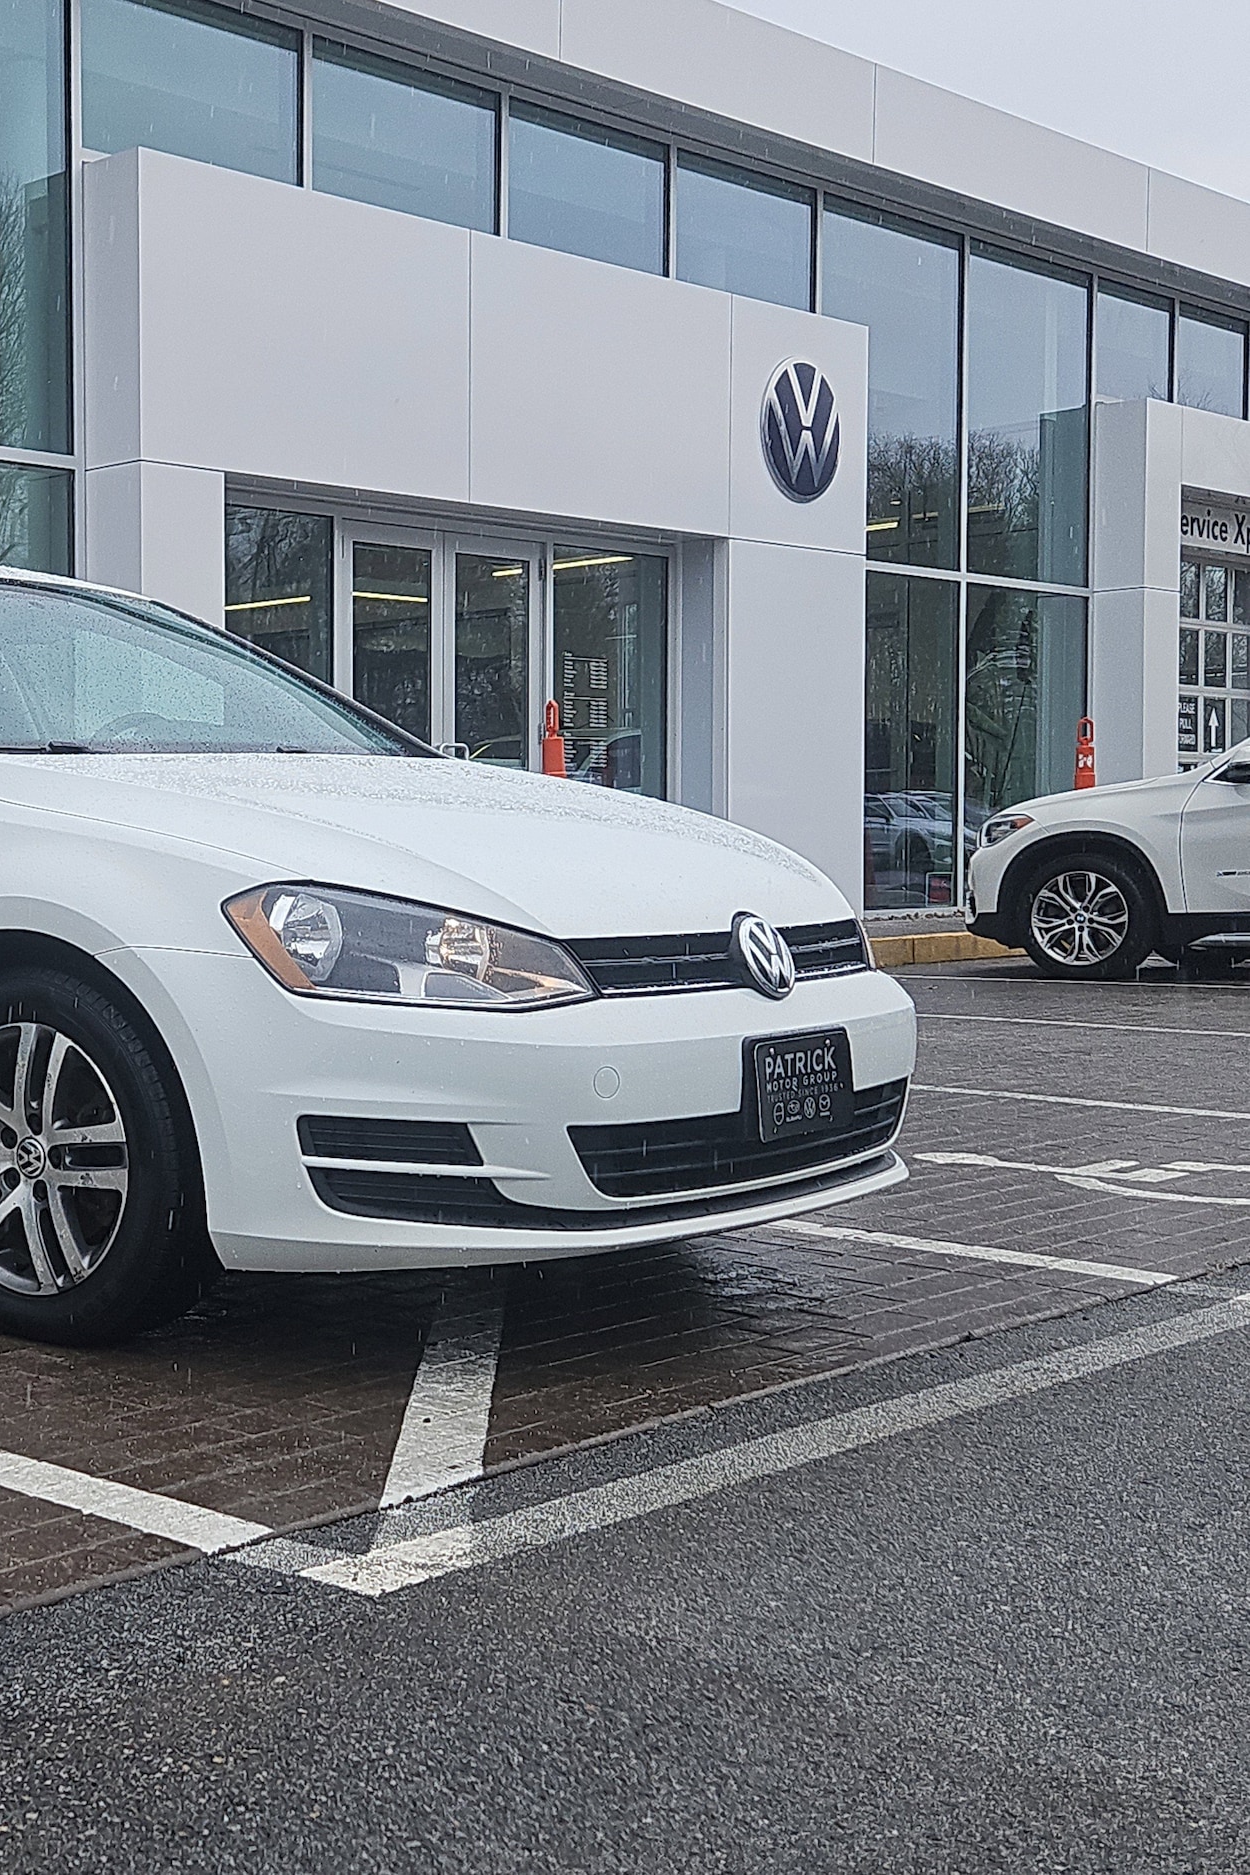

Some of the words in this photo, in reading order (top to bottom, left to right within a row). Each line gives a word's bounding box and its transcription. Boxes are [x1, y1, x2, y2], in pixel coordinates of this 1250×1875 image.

[765, 1046, 837, 1081] PATRICK
[766, 1077, 798, 1094] MOTOR
[803, 1071, 837, 1086] GROUP
